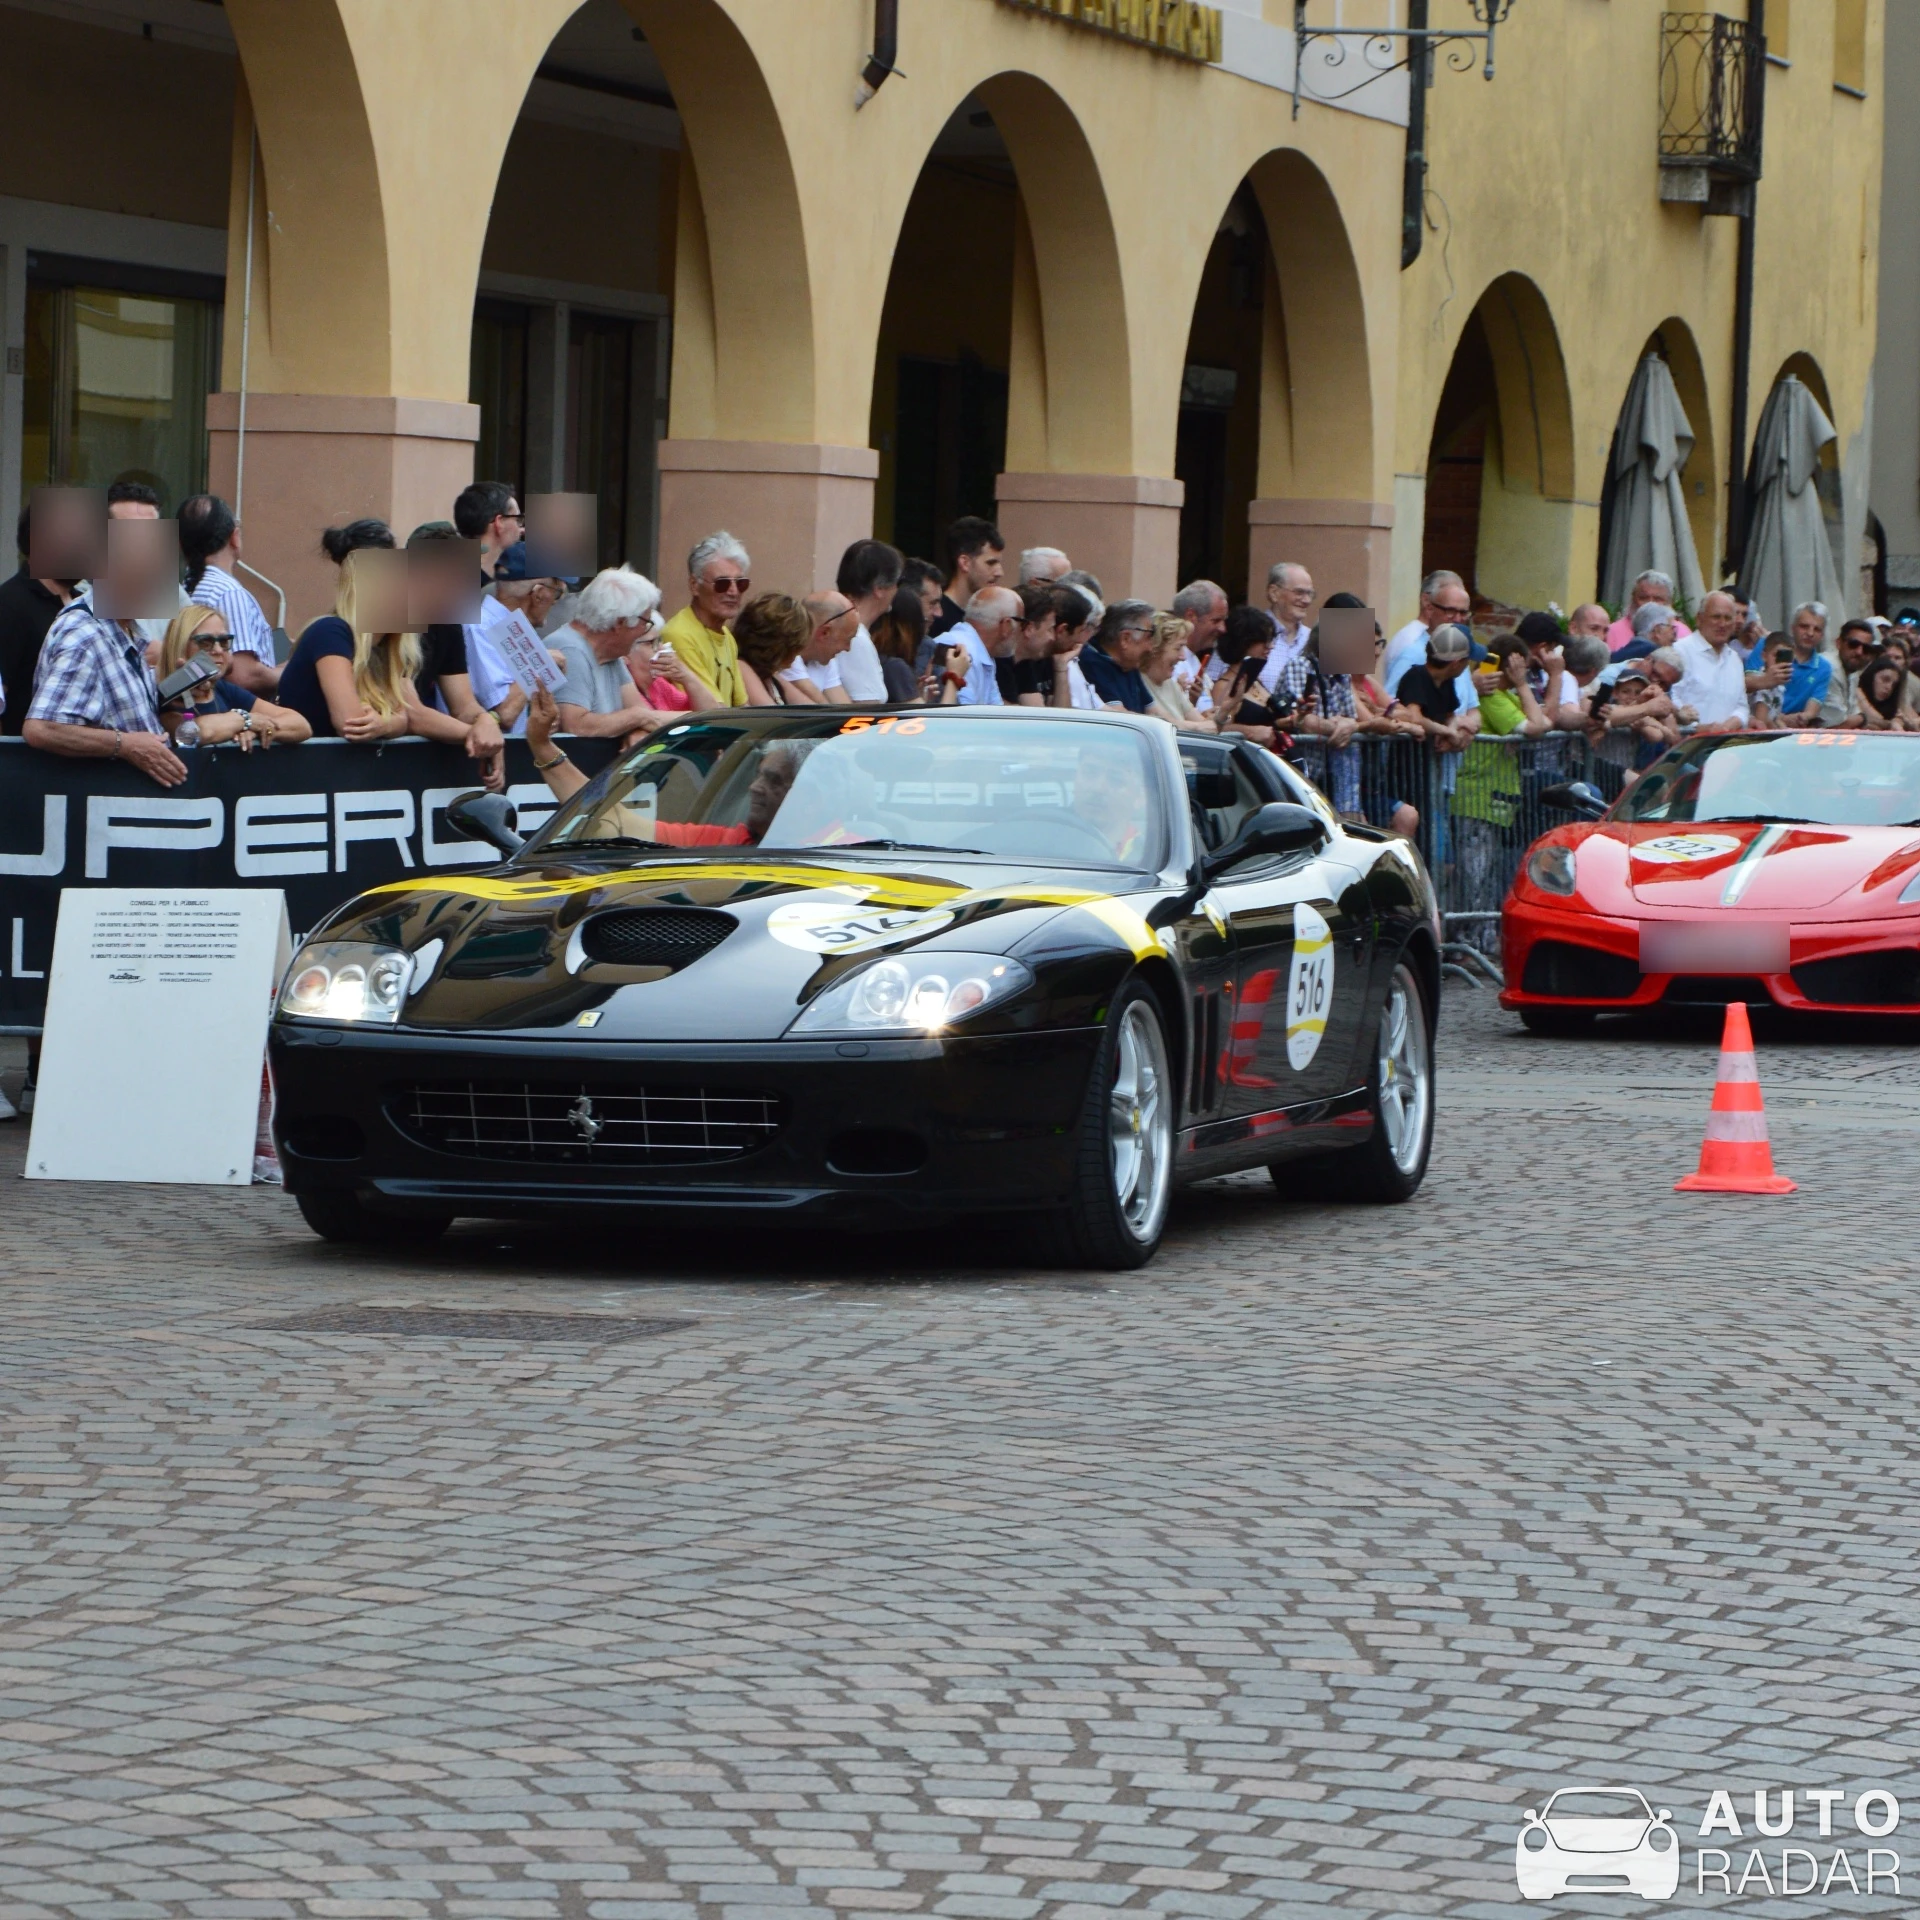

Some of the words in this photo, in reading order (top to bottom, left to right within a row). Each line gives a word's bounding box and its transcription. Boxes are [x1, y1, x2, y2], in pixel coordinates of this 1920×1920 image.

[839, 716, 927, 736] 516
[1797, 733, 1857, 746] 522
[1652, 839, 1717, 856] 522
[804, 917, 919, 943] 516
[1296, 958, 1326, 1017] 516
